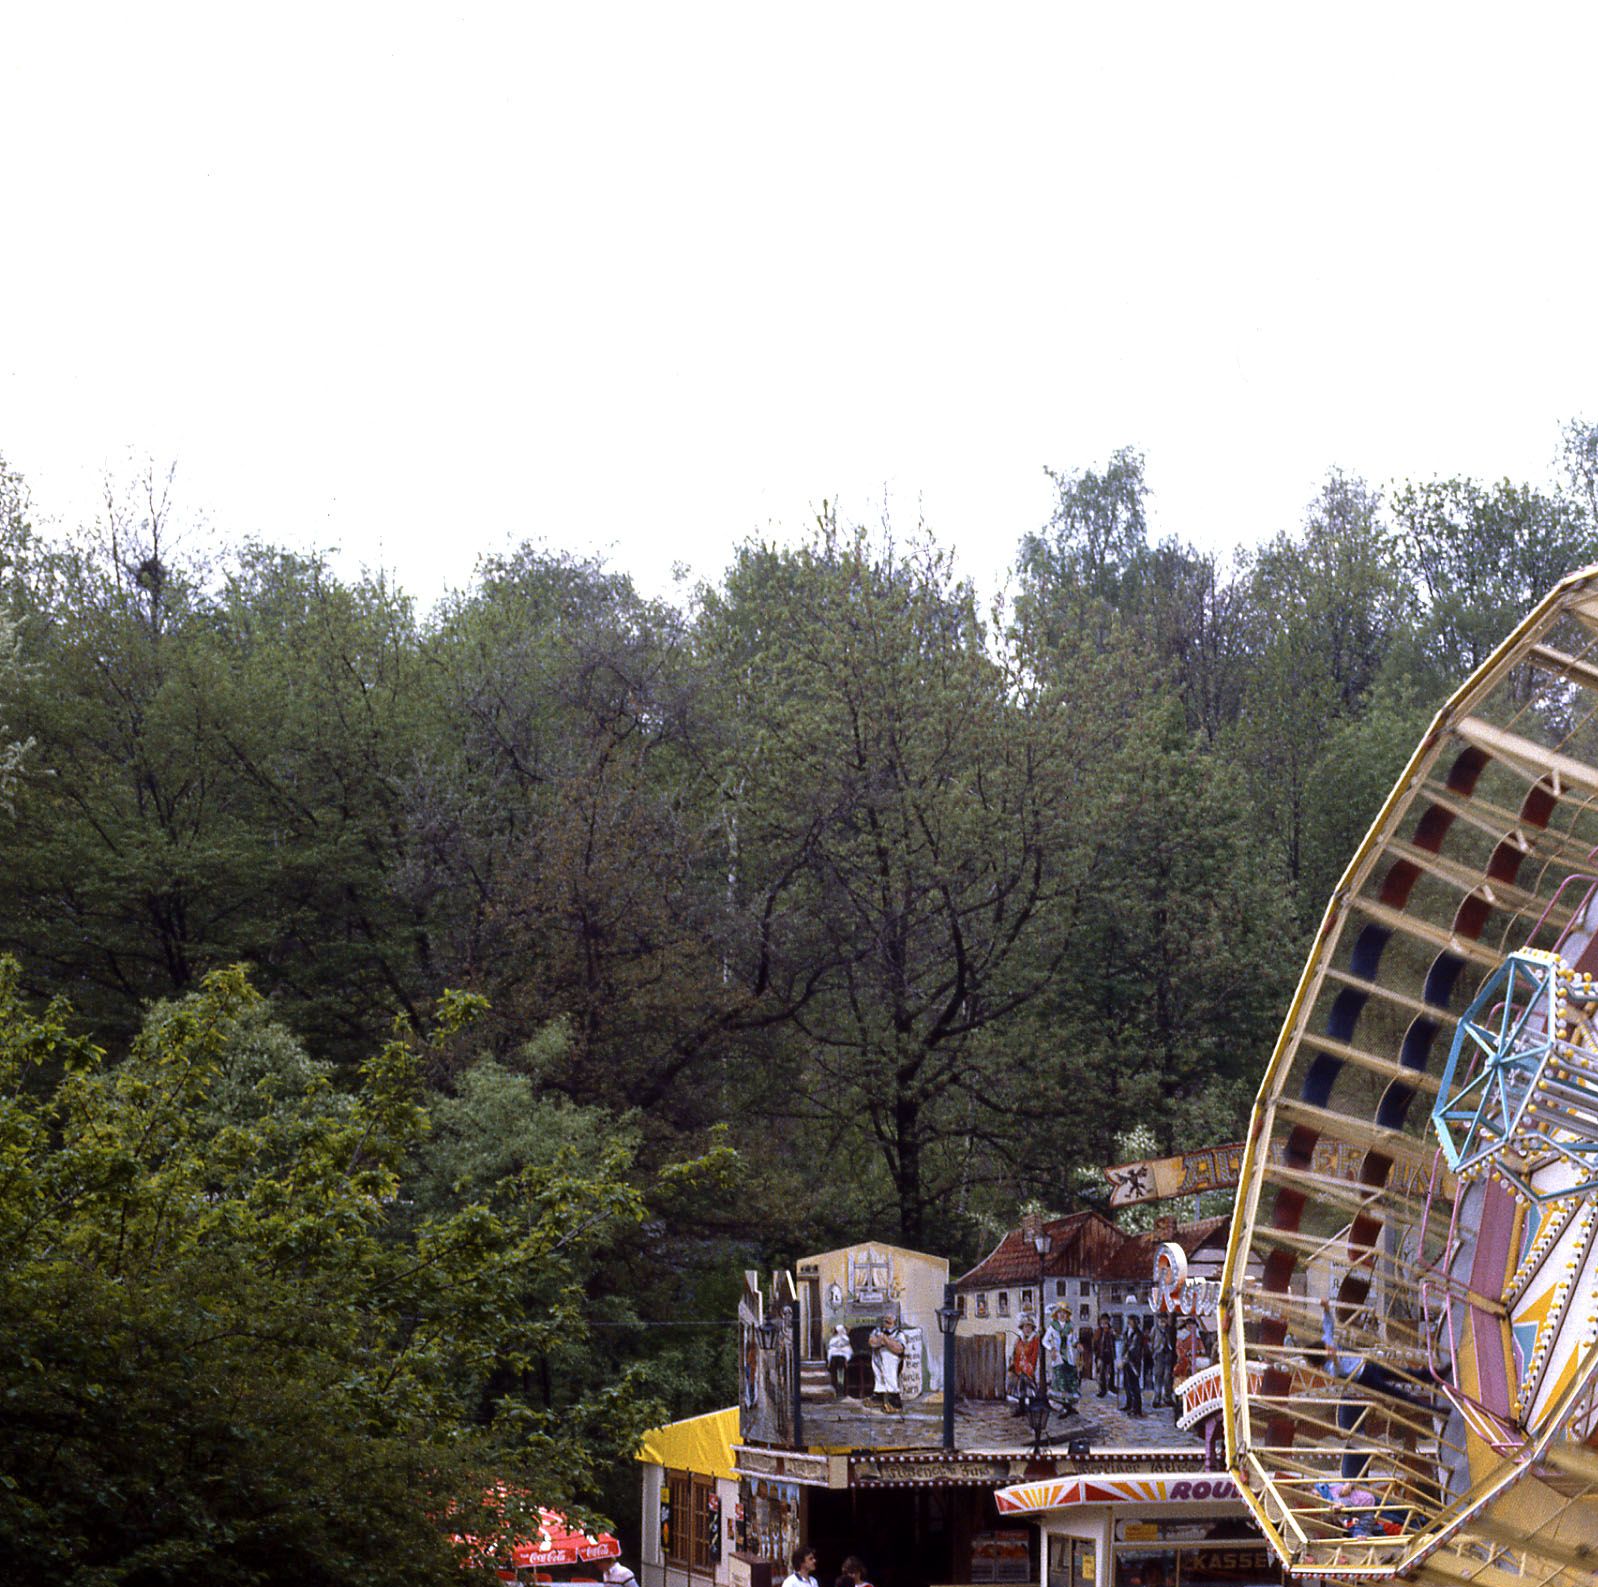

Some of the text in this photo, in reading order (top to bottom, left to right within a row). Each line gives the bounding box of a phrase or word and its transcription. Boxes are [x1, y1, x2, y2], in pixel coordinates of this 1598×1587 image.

[1182, 1149, 1246, 1190] AL
[529, 1549, 566, 1564] Coca-Cola
[1193, 1552, 1267, 1570] KASSE
